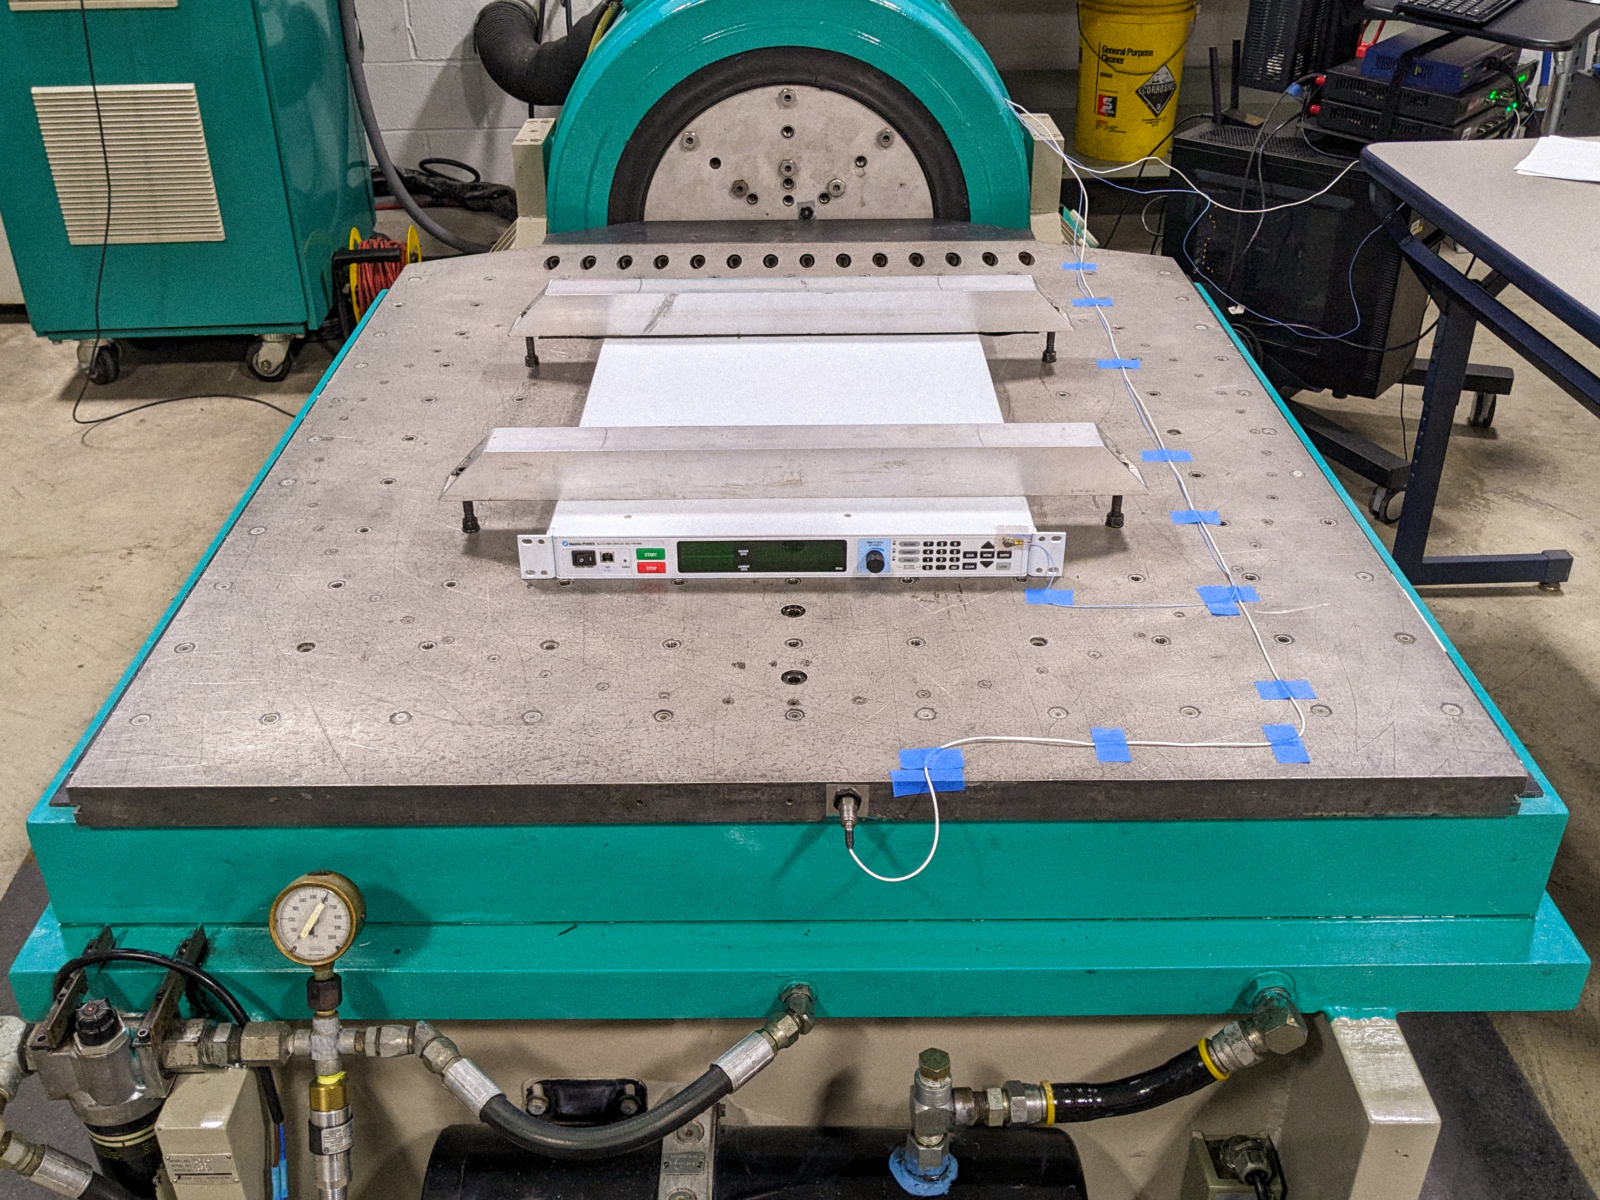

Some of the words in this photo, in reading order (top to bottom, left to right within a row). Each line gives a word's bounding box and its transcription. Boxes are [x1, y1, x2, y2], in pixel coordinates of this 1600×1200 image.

[1102, 44, 1126, 56] General
[1126, 48, 1154, 58] Purpose
[1101, 54, 1125, 64] Cleaner
[1142, 83, 1175, 94] CORROSIVE
